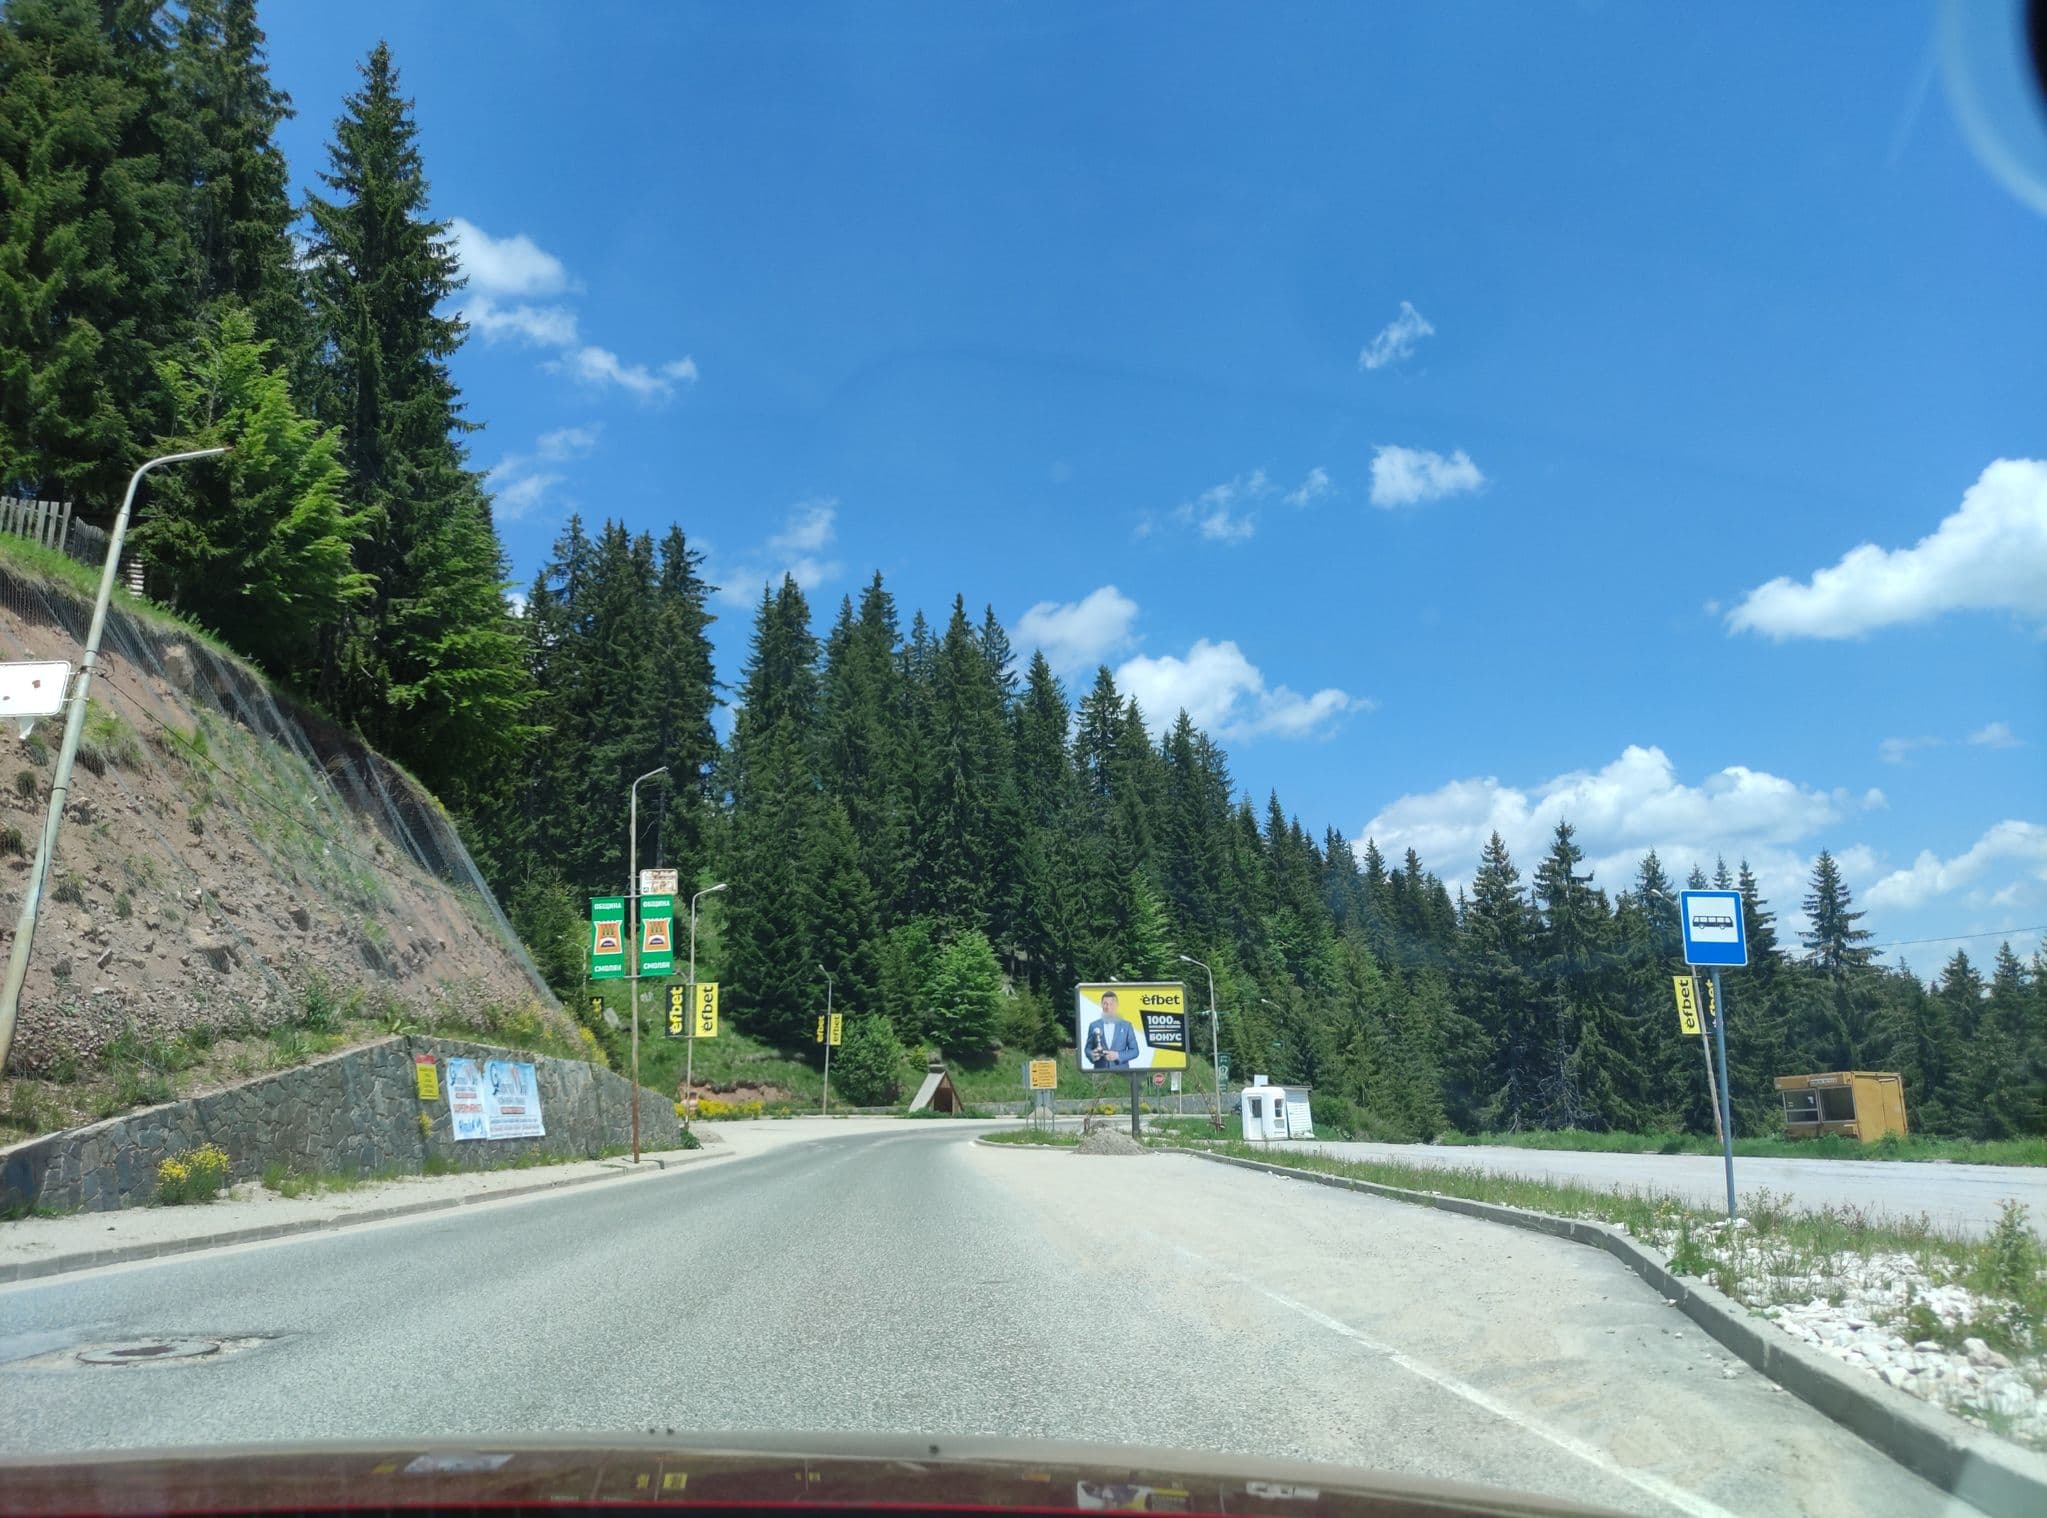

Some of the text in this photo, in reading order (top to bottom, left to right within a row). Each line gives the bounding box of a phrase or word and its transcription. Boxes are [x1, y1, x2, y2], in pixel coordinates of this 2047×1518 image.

[669, 986, 683, 1034] efbet
[702, 986, 714, 1032] efbet
[1140, 994, 1181, 1005] efbet
[1678, 979, 1695, 1029] efbet
[816, 1015, 825, 1043] efbet
[832, 1015, 841, 1042] efbet
[1149, 1033, 1182, 1041] БОНУС
